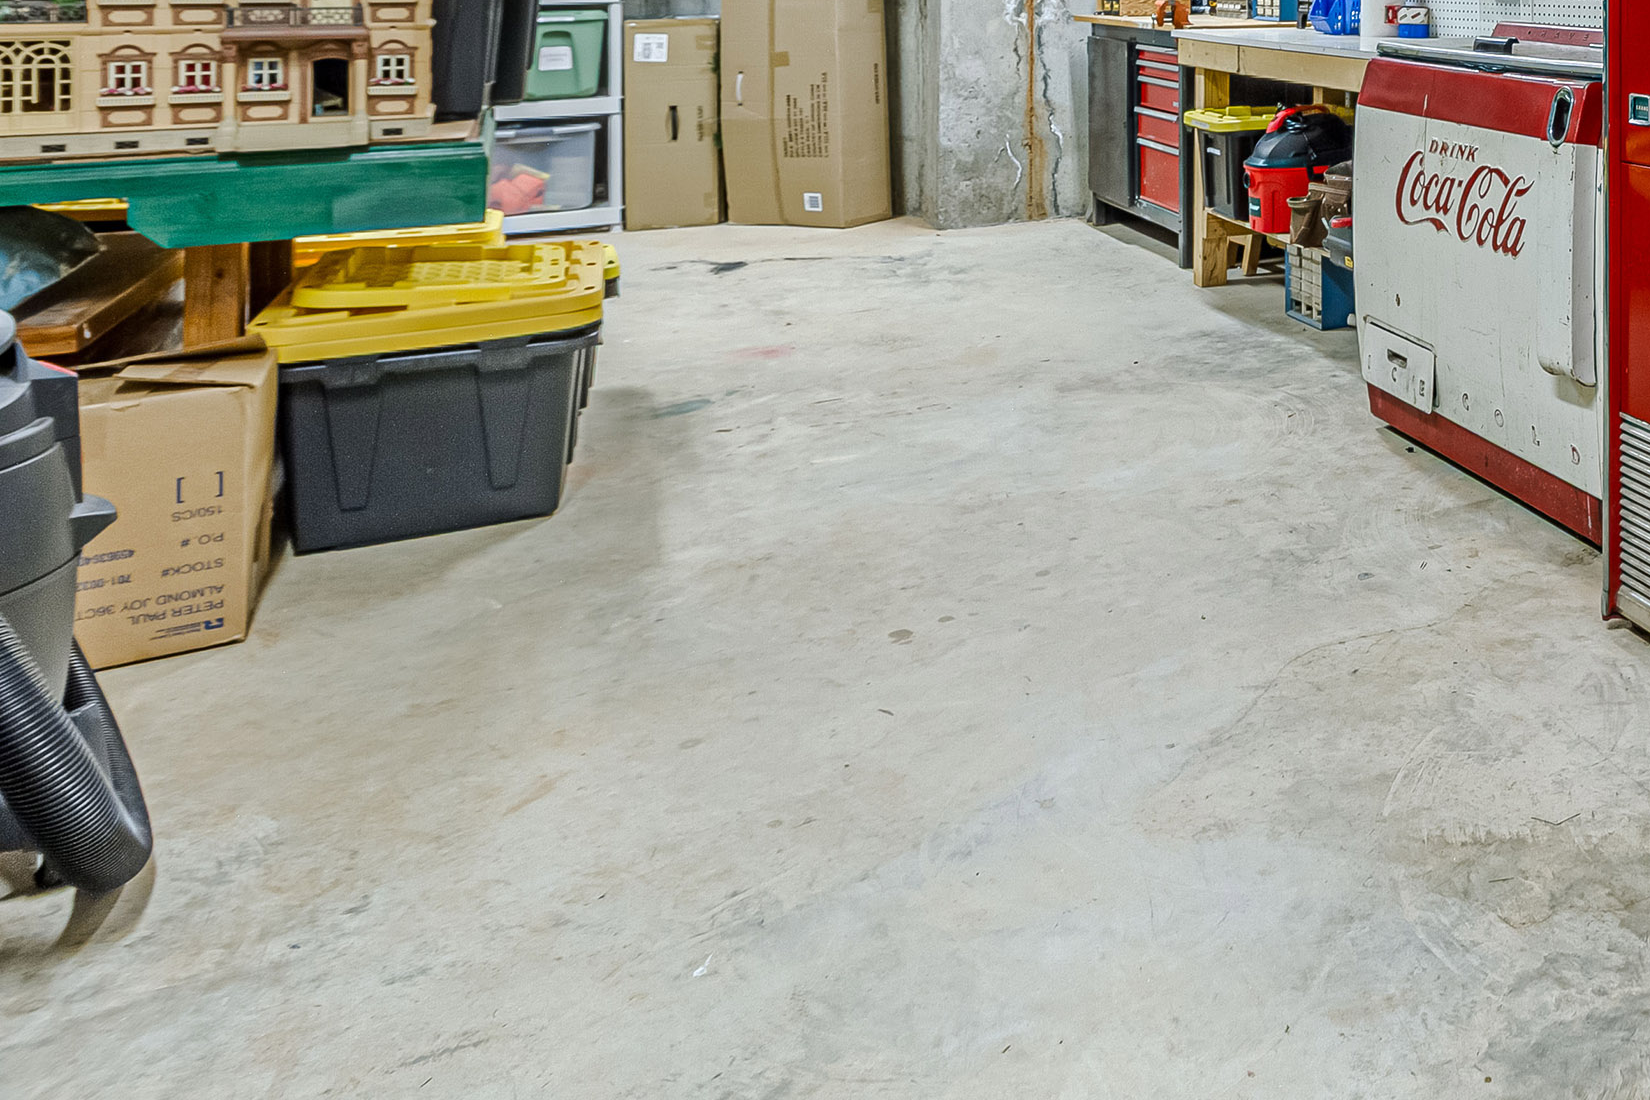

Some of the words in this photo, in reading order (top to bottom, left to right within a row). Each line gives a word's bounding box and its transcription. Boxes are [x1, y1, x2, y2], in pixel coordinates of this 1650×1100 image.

[1429, 138, 1478, 162] DRINK
[1396, 150, 1535, 259] Coca-Cola
[171, 505, 224, 523] 150/CS
[160, 557, 224, 578] STOCK#
[155, 584, 225, 606] ALMOND
[120, 597, 152, 614] JOY
[171, 599, 224, 618] PETER
[127, 609, 167, 625] PAUL
